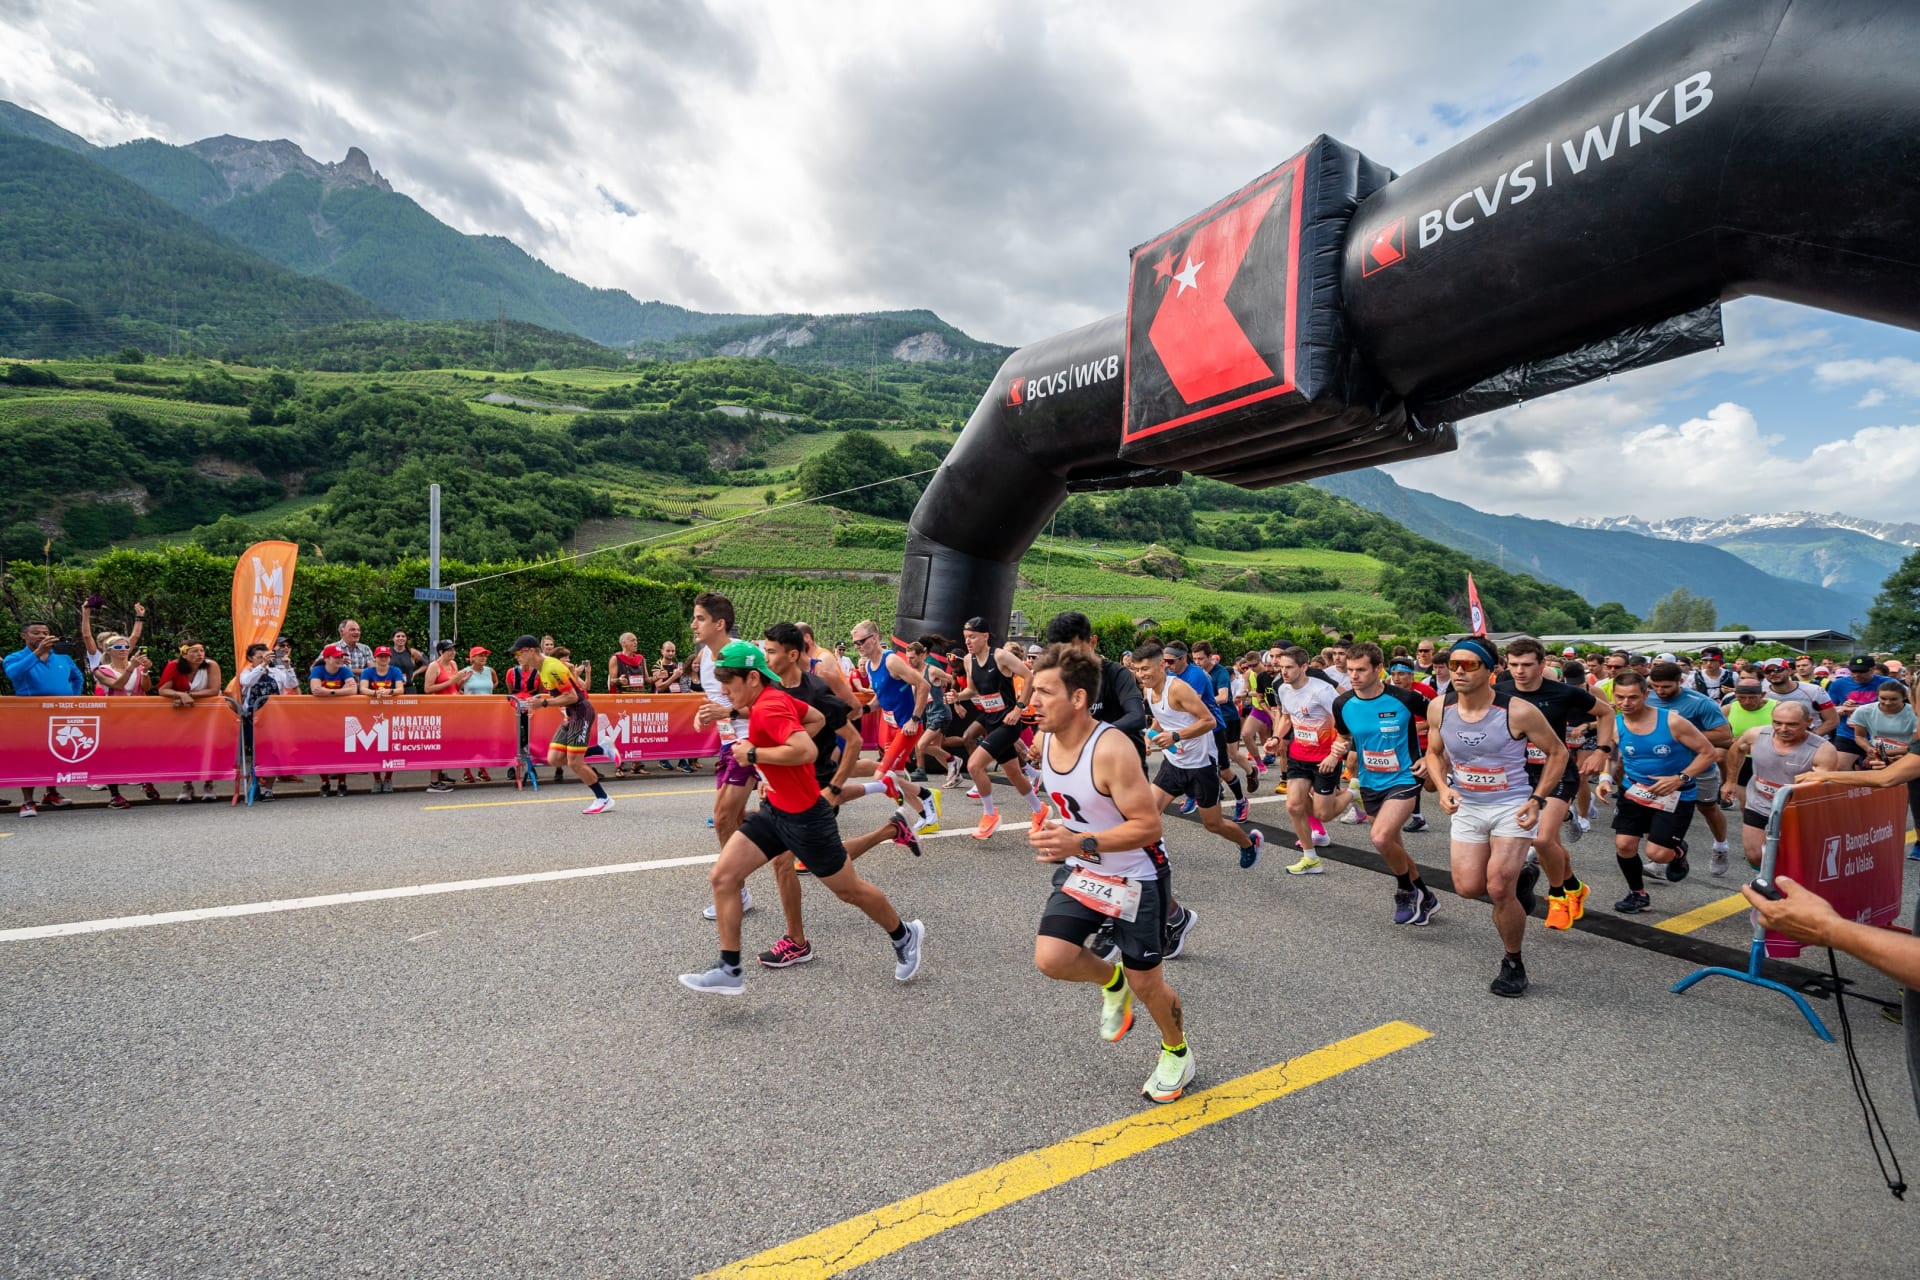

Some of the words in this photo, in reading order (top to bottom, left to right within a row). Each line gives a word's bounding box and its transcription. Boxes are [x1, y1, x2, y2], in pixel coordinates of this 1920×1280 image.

[392, 715, 442, 727] MARATHON
[632, 712, 669, 722] MARATHON
[632, 726, 641, 734] DU
[644, 725, 669, 733] VALAIS
[392, 731, 405, 740] DU
[408, 730, 441, 740] VALAIS
[1367, 757, 1390, 765] 2260
[1466, 774, 1496, 783] 2212
[1845, 831, 1869, 851] Banque
[1869, 820, 1894, 844] Cantonale
[1844, 858, 1855, 876] du
[1855, 853, 1874, 874] Valais
[1078, 879, 1112, 899] 2374
